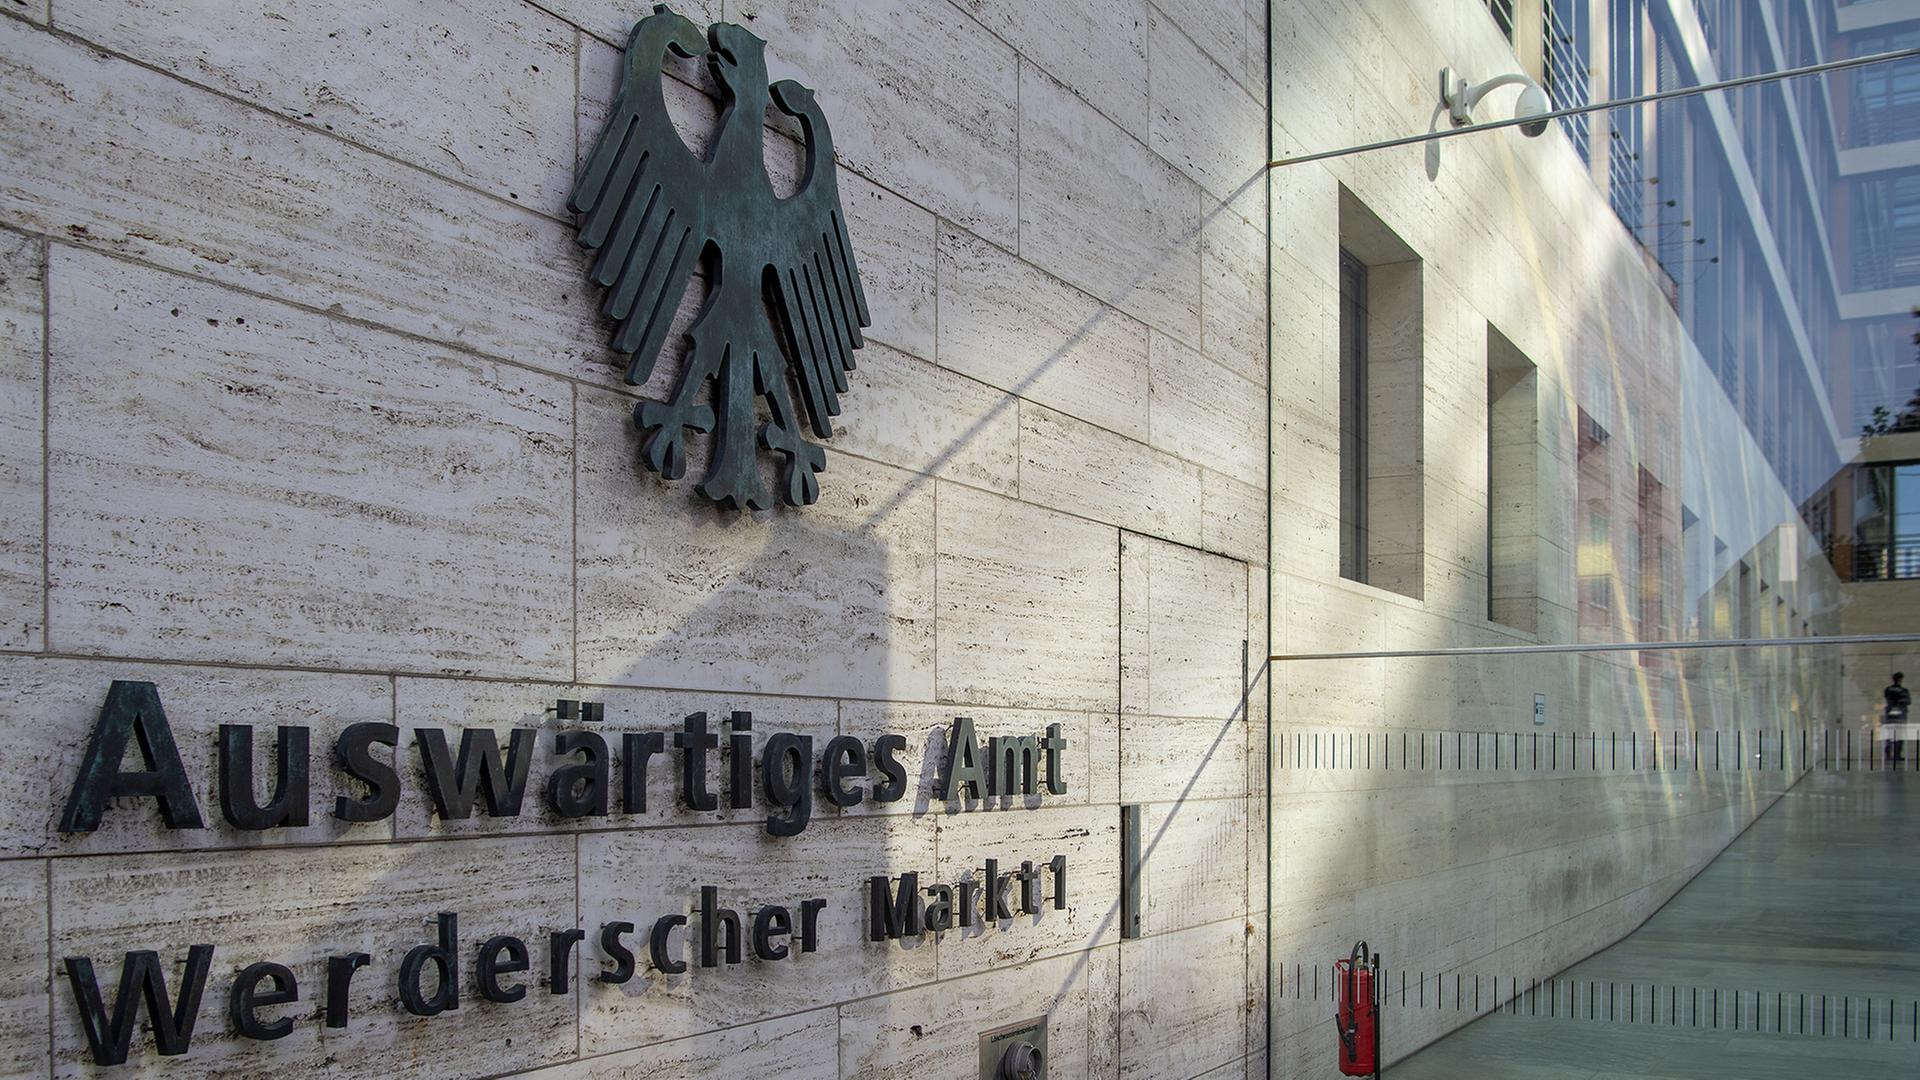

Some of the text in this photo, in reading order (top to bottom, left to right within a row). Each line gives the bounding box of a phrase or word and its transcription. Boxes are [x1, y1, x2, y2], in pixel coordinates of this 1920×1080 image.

[57, 680, 1067, 836] Auswärtiges Amt
[63, 886, 826, 1066] Werderscher
